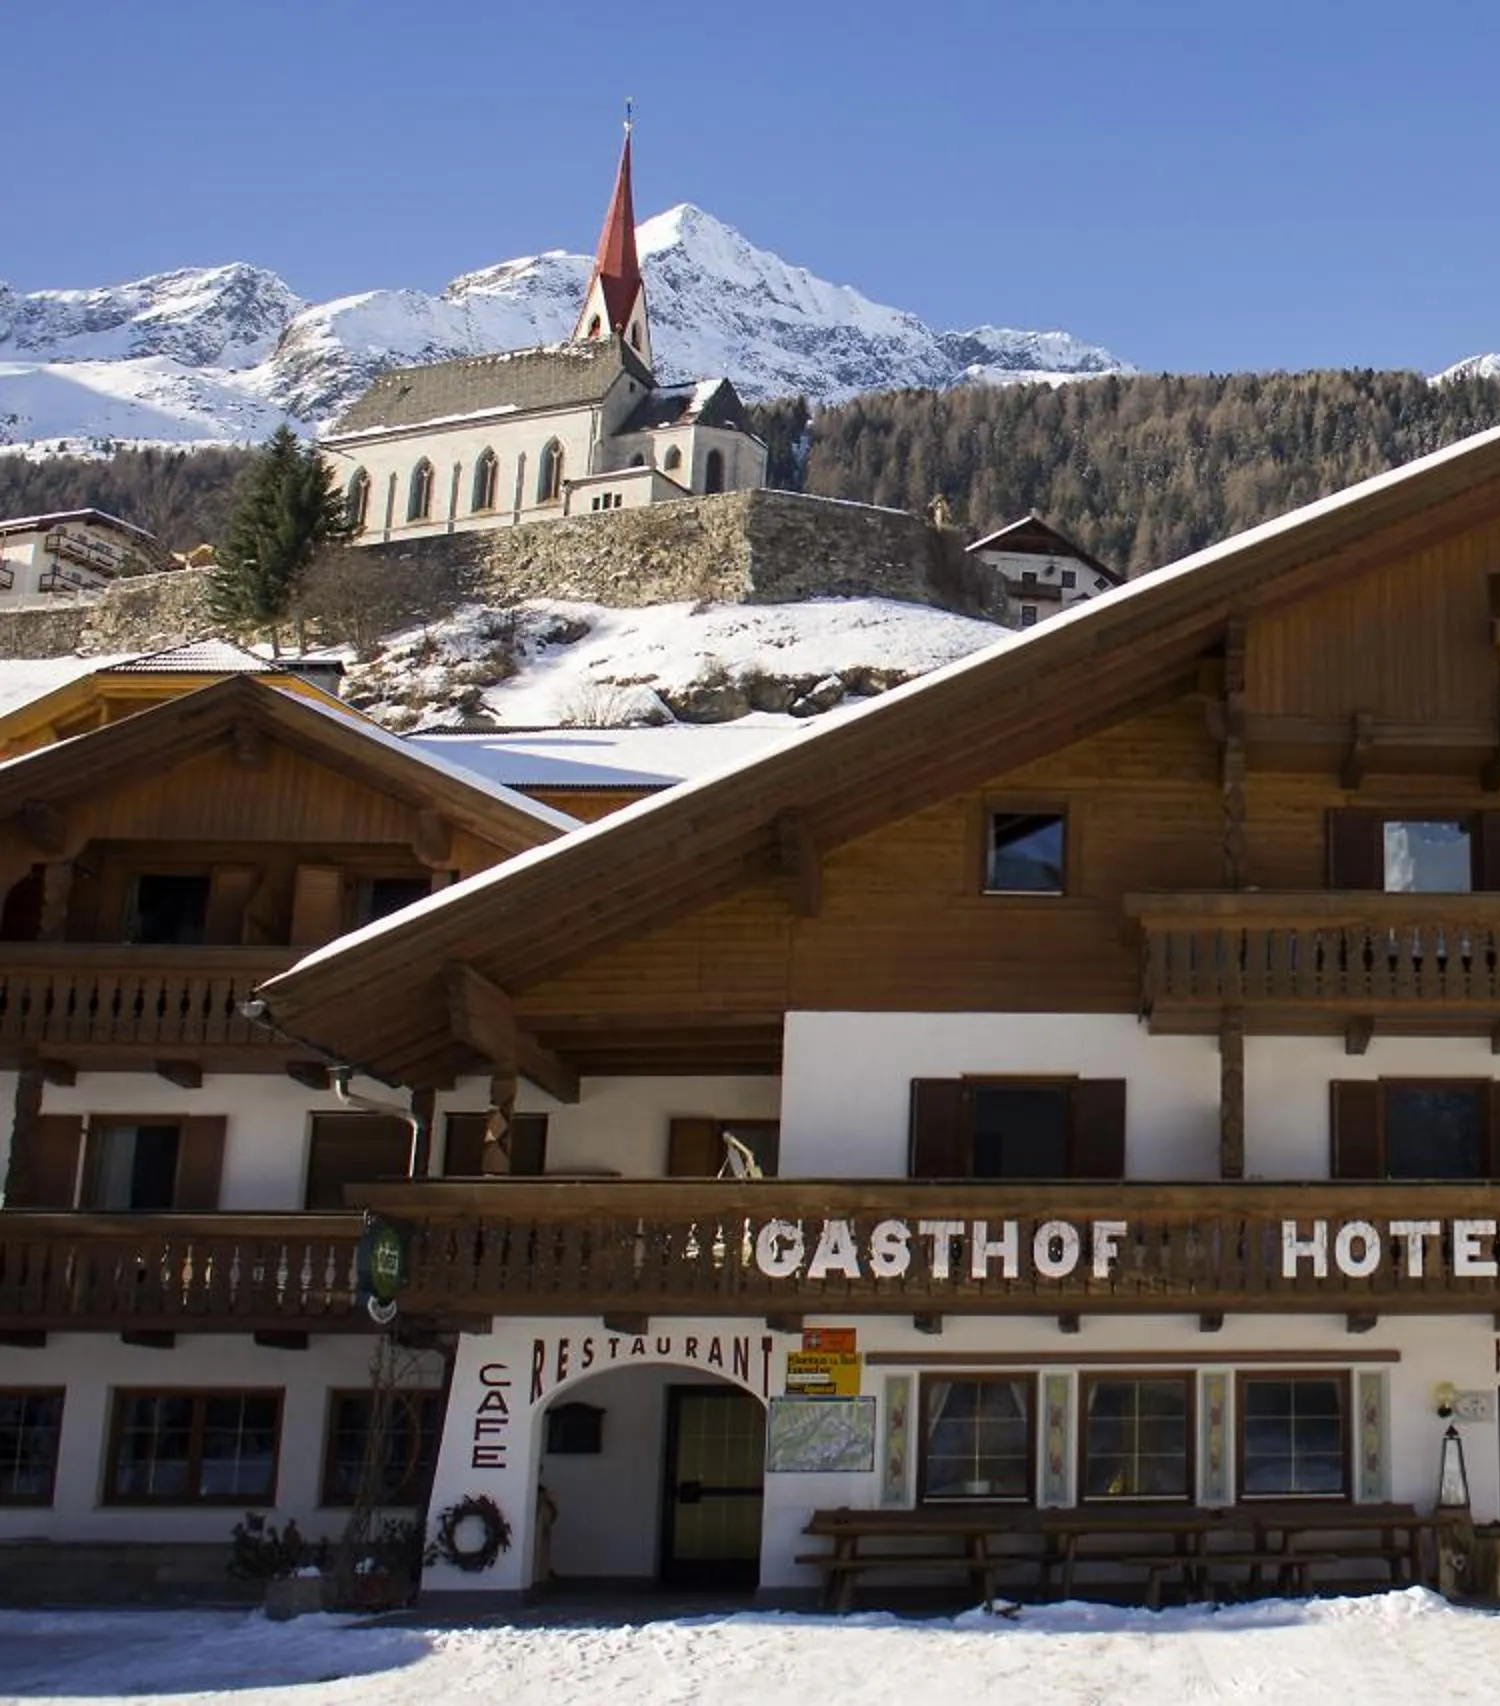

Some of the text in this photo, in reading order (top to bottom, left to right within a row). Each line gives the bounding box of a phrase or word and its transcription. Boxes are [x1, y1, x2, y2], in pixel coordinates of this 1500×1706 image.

[756, 1220, 1128, 1278] GASTHOF
[529, 1337, 773, 1405] RESTAURANT
[471, 1363, 511, 1468] CAFE
